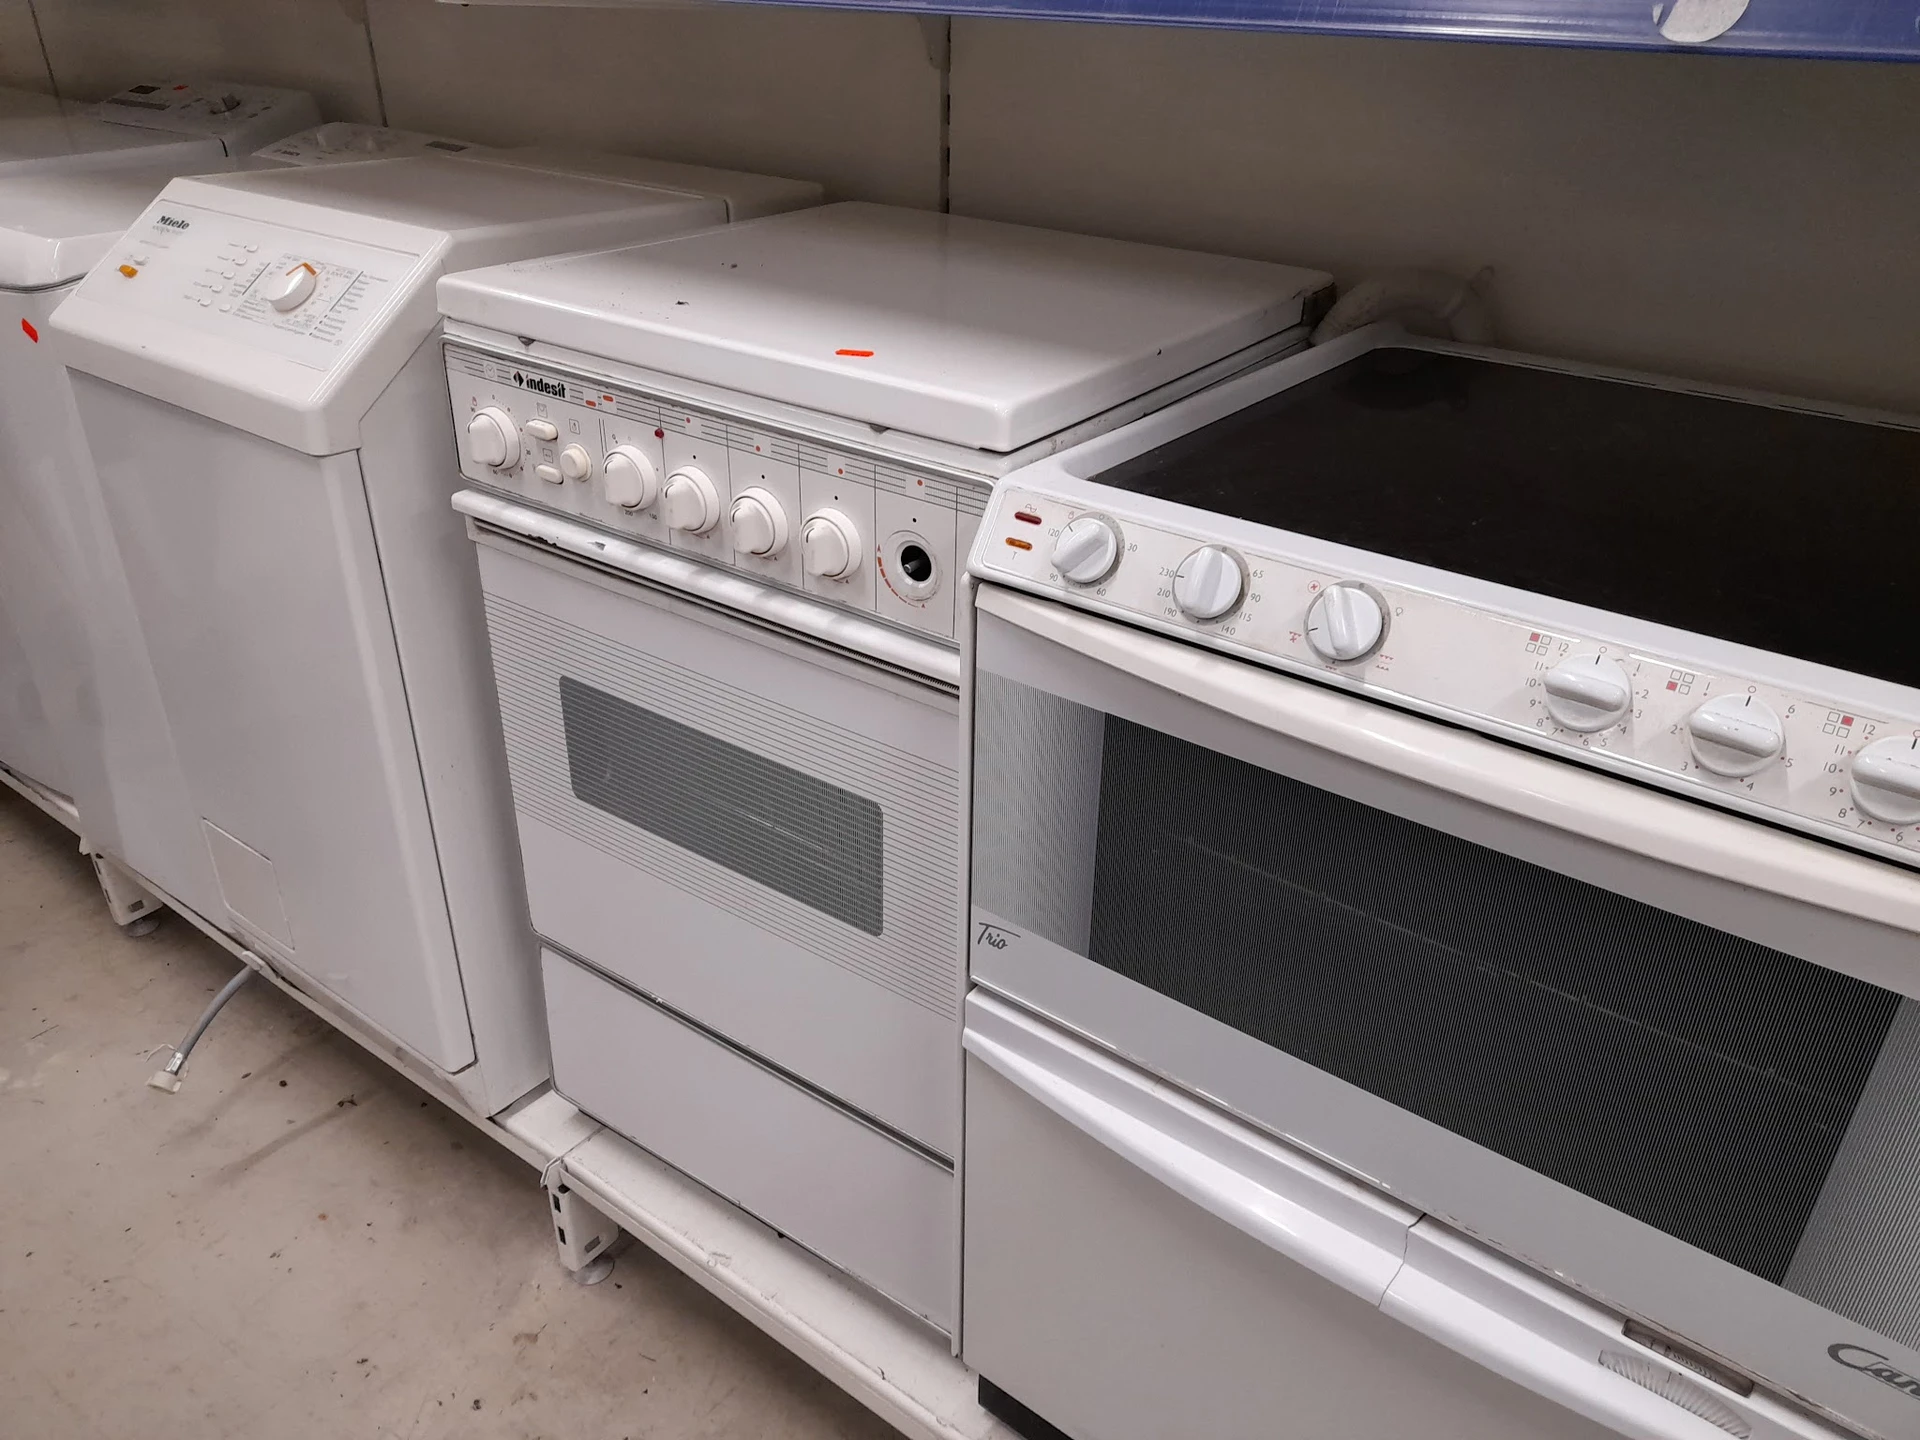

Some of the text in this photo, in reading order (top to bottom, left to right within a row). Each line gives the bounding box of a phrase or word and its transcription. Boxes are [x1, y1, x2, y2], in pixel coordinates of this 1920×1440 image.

[156, 215, 190, 230] Miele
[526, 373, 566, 398] indesit
[1047, 528, 1060, 538] 120
[1127, 543, 1138, 552] 30
[1049, 573, 1058, 582] 90
[1158, 567, 1175, 578] 230
[1252, 570, 1264, 579] 65
[1096, 588, 1106, 596] 60
[1156, 587, 1171, 598] 210
[1250, 593, 1261, 603] 90
[1163, 606, 1177, 617] 190
[1239, 612, 1252, 622] 115
[1221, 625, 1236, 635] 140
[1558, 642, 1569, 653] 12
[1534, 661, 1544, 671] 11
[1525, 677, 1537, 687] 10
[1641, 689, 1649, 699] 2
[1530, 699, 1536, 708] 9
[1635, 709, 1643, 719] 3
[1787, 704, 1796, 715] 6
[1536, 718, 1544, 727] 8
[1551, 727, 1559, 735] 7
[1620, 726, 1627, 735] 4
[1670, 724, 1678, 735] 2
[1862, 723, 1876, 736] 12
[1582, 737, 1589, 746] 6
[1600, 738, 1608, 747] 5
[1834, 744, 1845, 755] 11
[1681, 761, 1688, 771] 3
[1785, 758, 1794, 768] 5
[1823, 761, 1837, 773] 10
[1746, 782, 1755, 791] 4
[1829, 786, 1837, 797] 9
[1838, 808, 1847, 818] 8
[1857, 819, 1865, 828] 7
[1895, 831, 1903, 842] 6
[977, 922, 1021, 950] Trio
